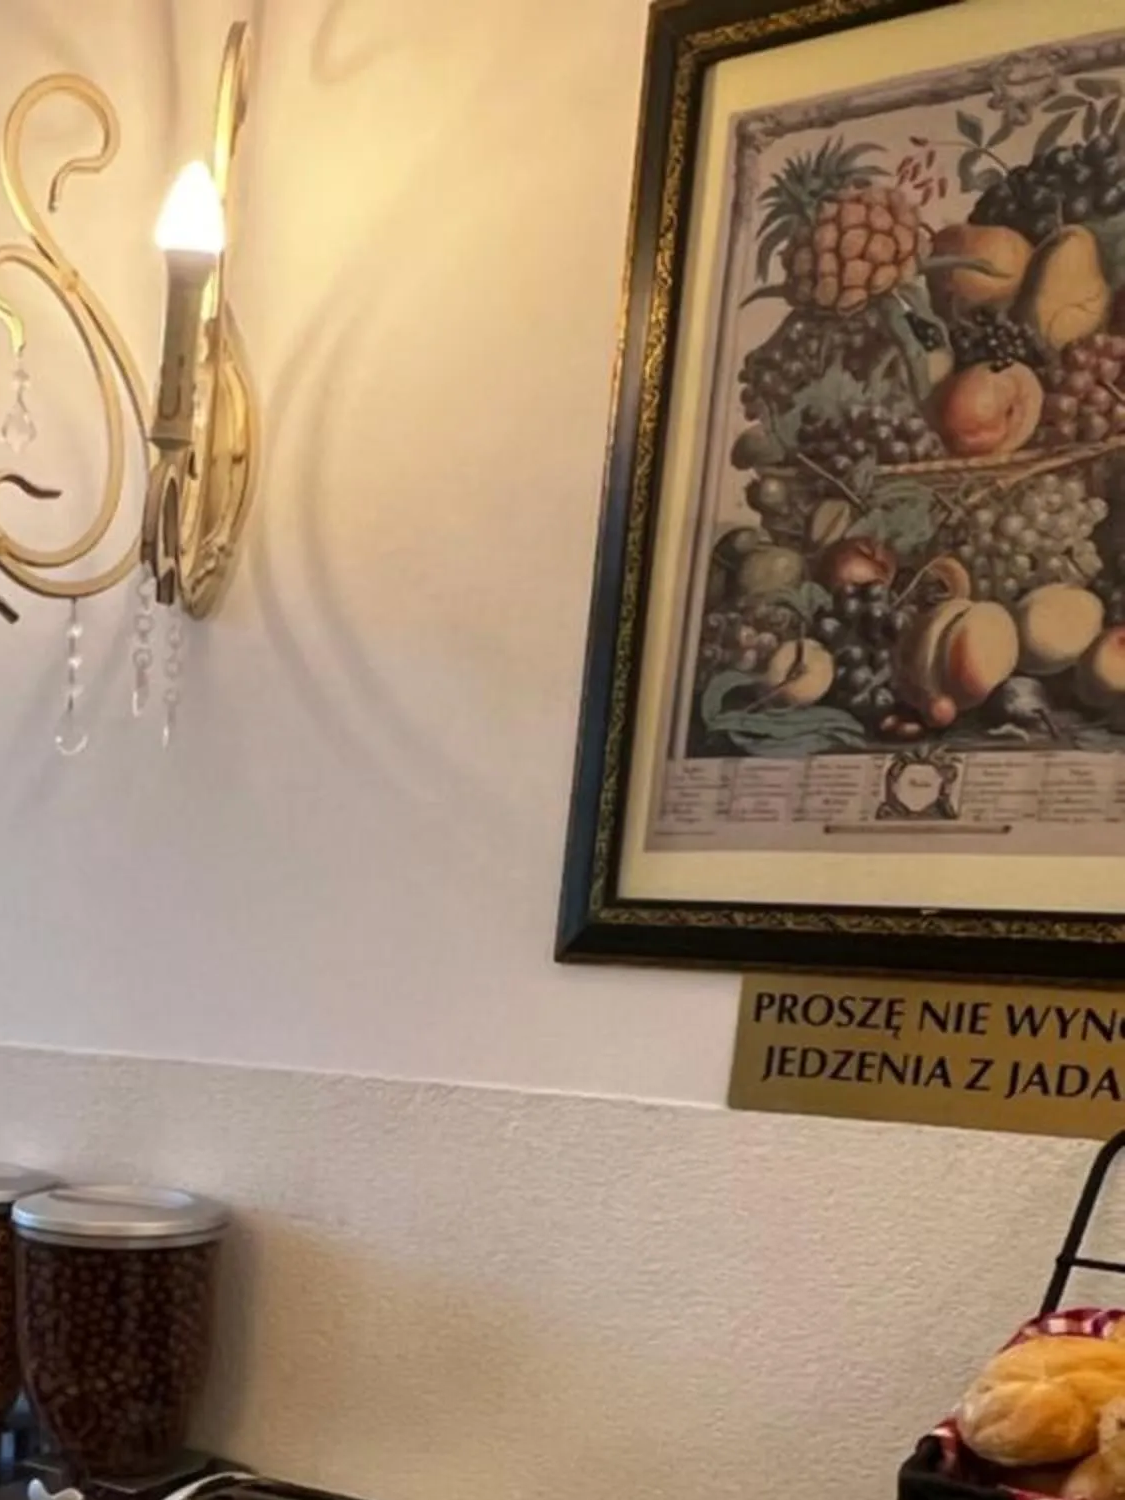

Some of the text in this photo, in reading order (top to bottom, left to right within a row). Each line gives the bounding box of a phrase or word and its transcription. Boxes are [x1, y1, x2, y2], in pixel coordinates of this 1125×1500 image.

[753, 992, 1125, 1043] PROSZĘ NIE WYN
[761, 1045, 1122, 1102] JEDZENIA Z JADA
